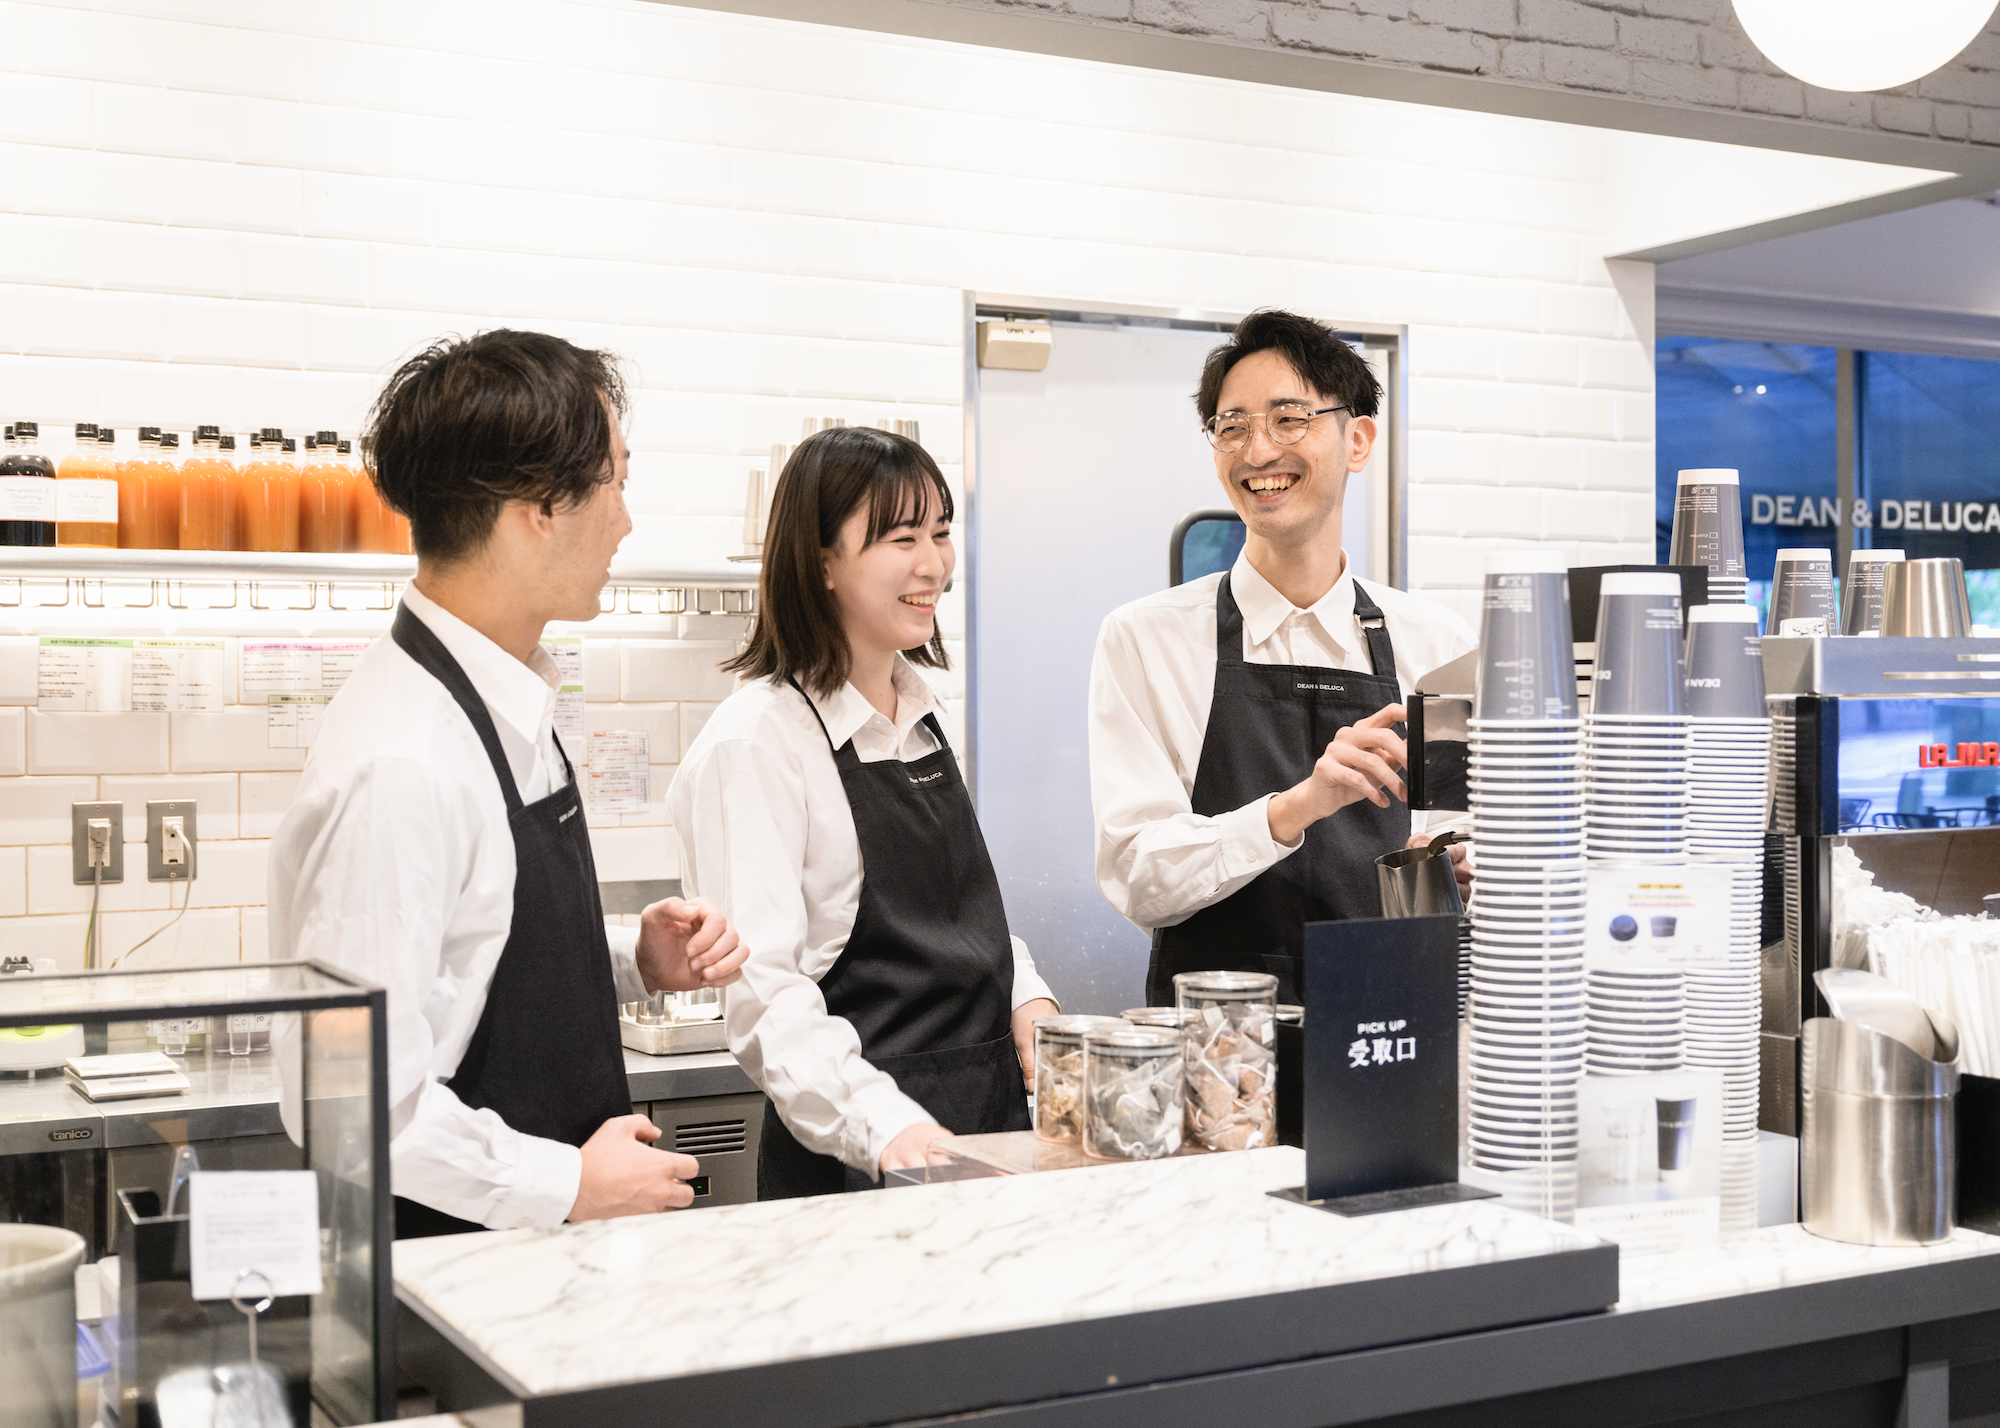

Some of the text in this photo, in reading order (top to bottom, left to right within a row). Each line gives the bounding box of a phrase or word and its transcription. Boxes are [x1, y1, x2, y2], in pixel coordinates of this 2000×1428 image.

[1751, 495, 1842, 527] DEAN
[1852, 499, 1873, 528] &
[1880, 500, 2000, 533] DELUCA
[1956, 741, 2000, 767] MA
[1357, 1019, 1407, 1035] PICK UP
[1348, 1036, 1416, 1069] 受取口
[52, 1130, 90, 1140] tanico
